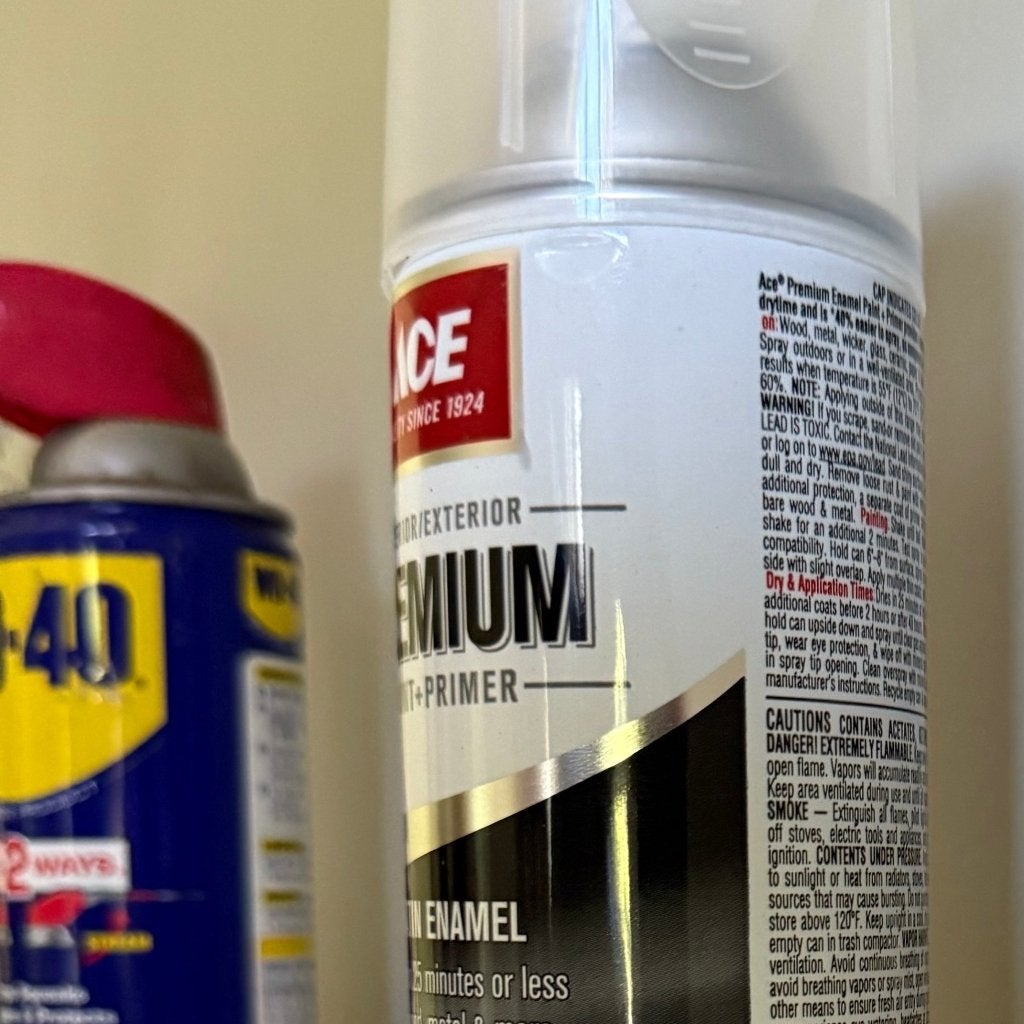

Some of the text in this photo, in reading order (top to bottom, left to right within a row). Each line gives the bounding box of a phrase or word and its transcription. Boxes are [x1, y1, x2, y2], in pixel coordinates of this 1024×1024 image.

[787, 276, 829, 303] Premium
[759, 295, 798, 315] drytime
[779, 316, 810, 340] Wood,
[760, 333, 833, 362] Spray outdoors
[760, 355, 820, 379] results when
[760, 374, 821, 398] 60%. NOTE:
[407, 399, 442, 432] SINCE
[447, 390, 485, 419] 1924
[761, 393, 815, 417] WARNING!
[761, 413, 832, 441] LEAD TOXIC.
[776, 435, 790, 456] log
[762, 454, 860, 485] dull Remove
[762, 474, 856, 506] additional protection,
[763, 493, 815, 516] bare wood
[763, 513, 791, 532] shake
[763, 536, 848, 560] compatibility. Hold
[764, 554, 784, 570] side
[766, 571, 848, 597] Dry Application
[764, 595, 836, 615] additional coats
[0, 582, 133, 690] -40
[765, 612, 836, 636] hold upside
[765, 632, 807, 651] tip, wear
[780, 655, 859, 677] spray opening.
[766, 673, 835, 691] manufacturer's
[766, 708, 882, 737] CAUTIONS CONTAINS
[767, 733, 874, 759] DANGER! EXTREMELY
[767, 758, 861, 782] open Vapors
[768, 778, 864, 802] Keep ventilated
[768, 800, 875, 826] SMOKE Extinguish
[789, 824, 861, 845] stoves, electric
[768, 846, 894, 868] ignition. CONTENTS UNDER
[785, 868, 862, 890] sunlight heat
[769, 890, 832, 909] sources that
[426, 901, 527, 942] ENAMEL
[769, 912, 830, 931] store above
[770, 932, 860, 956] empty trash
[770, 953, 897, 975] ventilation. continuous
[425, 964, 484, 998] minutes
[492, 973, 513, 998] or
[522, 966, 570, 1000] less
[770, 976, 846, 998] avoid breathing
[770, 999, 834, 1019] other means
